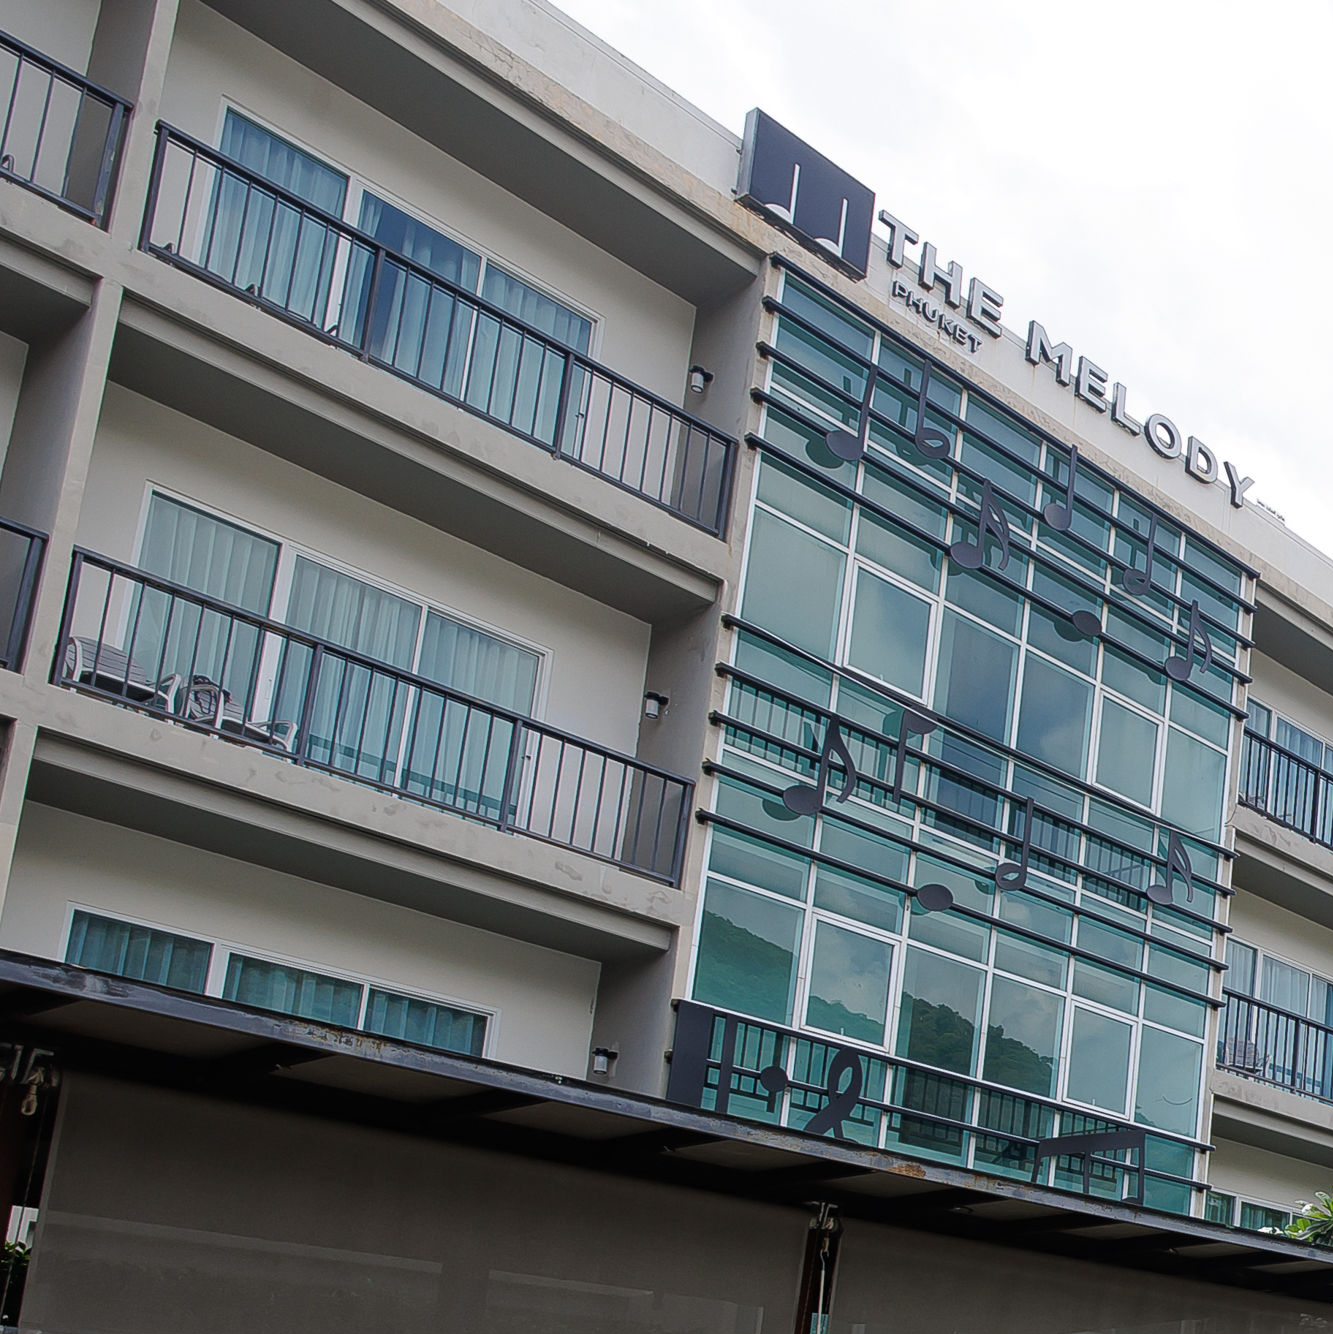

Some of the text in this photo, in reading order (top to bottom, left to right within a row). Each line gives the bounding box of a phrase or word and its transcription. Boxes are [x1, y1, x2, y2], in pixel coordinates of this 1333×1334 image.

[878, 209, 1255, 509] THE MELODY
[892, 280, 983, 354] PHUKET
